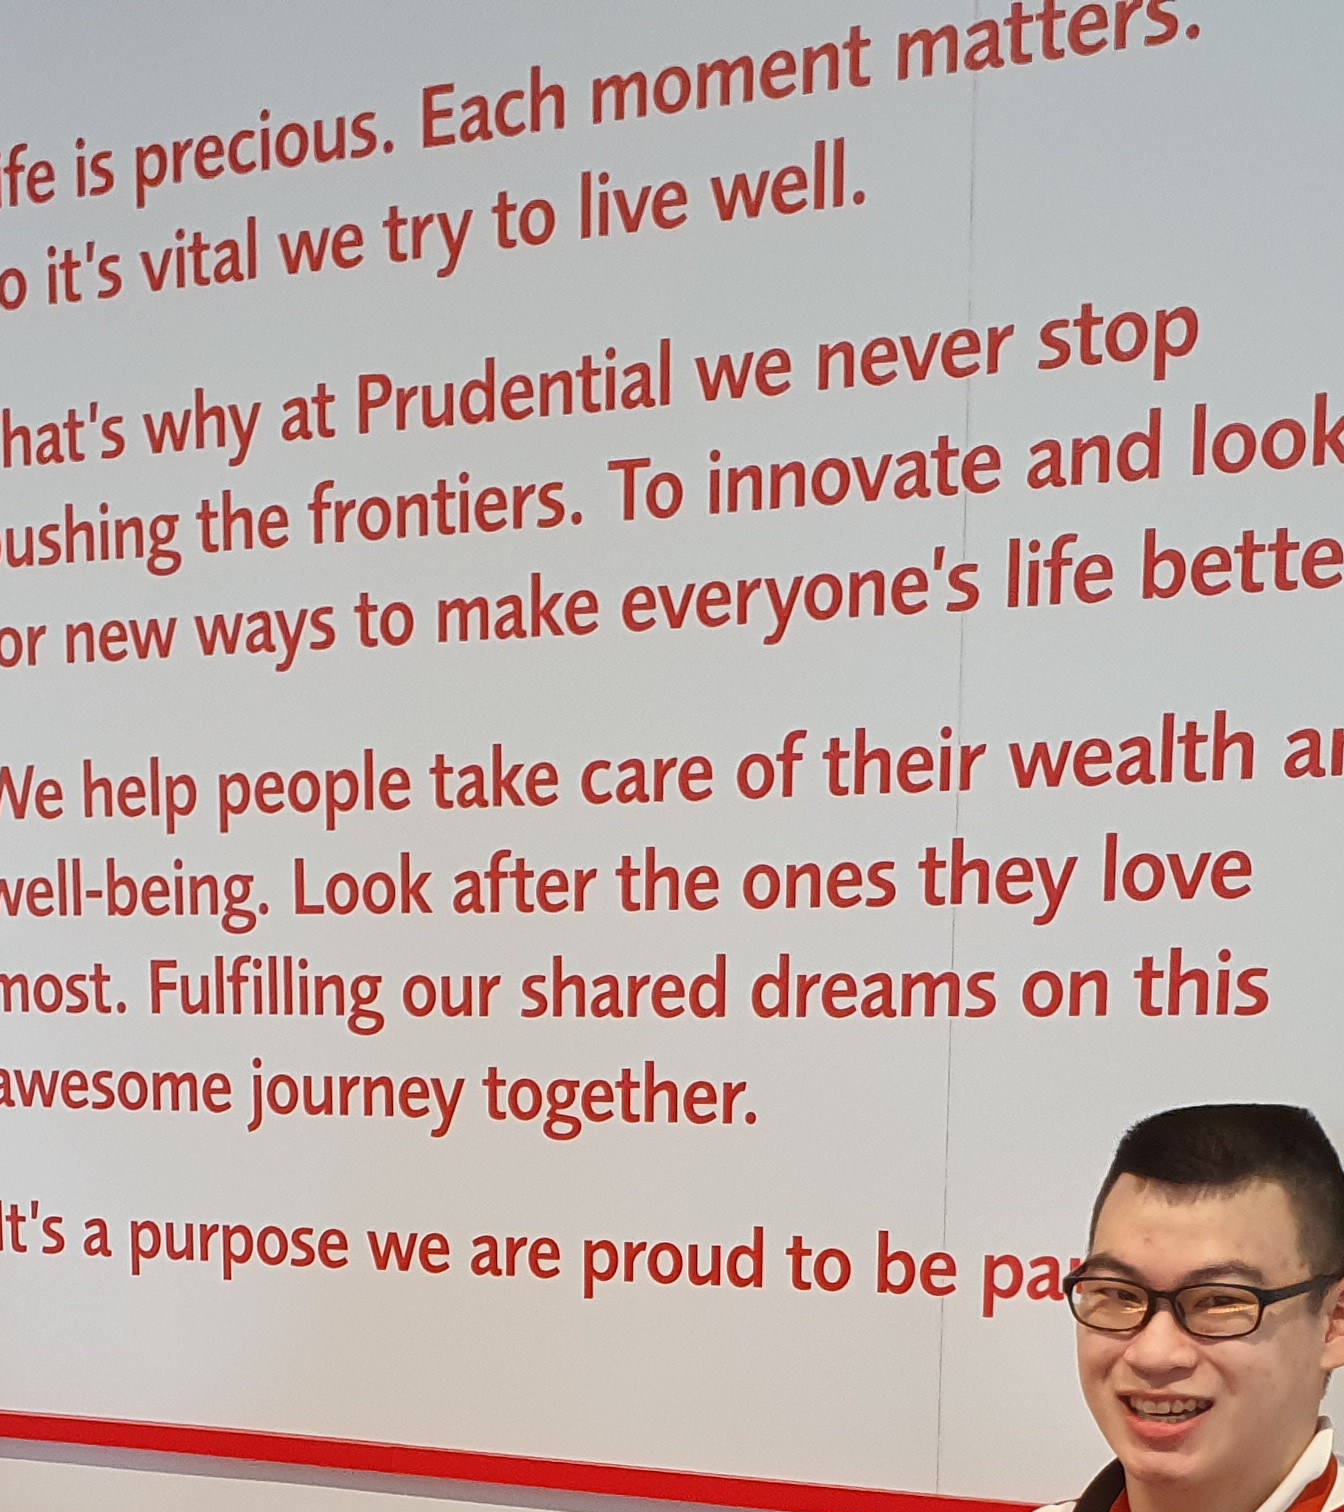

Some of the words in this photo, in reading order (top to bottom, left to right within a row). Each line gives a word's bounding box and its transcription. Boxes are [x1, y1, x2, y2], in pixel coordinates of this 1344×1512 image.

[78, 152, 114, 196] is
[136, 113, 393, 208] precious.
[424, 67, 565, 147] Each
[593, 27, 870, 124] moment
[899, 0, 1200, 80] matters.
[49, 243, 122, 304] it's
[142, 218, 257, 291] vital
[280, 225, 364, 275] we
[384, 207, 472, 278] try
[493, 193, 556, 249] to
[582, 173, 688, 238] live
[712, 139, 865, 221] well.
[144, 389, 261, 467] why
[283, 385, 336, 441] at
[359, 340, 671, 434] Prudential
[696, 349, 791, 401] we
[819, 326, 1014, 390] never
[1040, 304, 1199, 381] stop
[198, 491, 289, 553] the
[310, 473, 582, 544] frontiers.
[609, 459, 684, 521] To
[710, 437, 1001, 514] innovate
[1028, 409, 1161, 489] and
[67, 619, 177, 663] new
[196, 607, 336, 672] ways
[355, 594, 414, 648] to
[439, 573, 599, 642] make
[622, 547, 980, 645] everyone's
[1008, 534, 1114, 608] life
[84, 758, 197, 835] help
[220, 749, 411, 833] people
[430, 745, 559, 810] take
[582, 757, 714, 805] care
[738, 731, 808, 800] of
[824, 727, 986, 797] their
[1010, 711, 1254, 789] wealth
[295, 852, 432, 916] Look
[454, 850, 598, 914] after
[616, 847, 720, 912] the
[744, 861, 896, 910] ones
[919, 838, 1077, 926] they
[1104, 833, 1252, 902] love
[151, 956, 385, 1036] Fulfilling
[404, 975, 502, 1018] our
[522, 954, 727, 1019] shared
[752, 954, 997, 1019] dreams
[1023, 971, 1108, 1018] on
[1135, 948, 1269, 1017] this
[249, 1059, 465, 1138] journey
[483, 1061, 757, 1142] together.
[85, 1218, 112, 1257] a
[131, 1221, 349, 1281] purpose
[368, 1232, 451, 1274] we
[471, 1235, 561, 1280] are
[584, 1226, 765, 1300] proud
[786, 1236, 852, 1292] to
[878, 1231, 958, 1297] be
